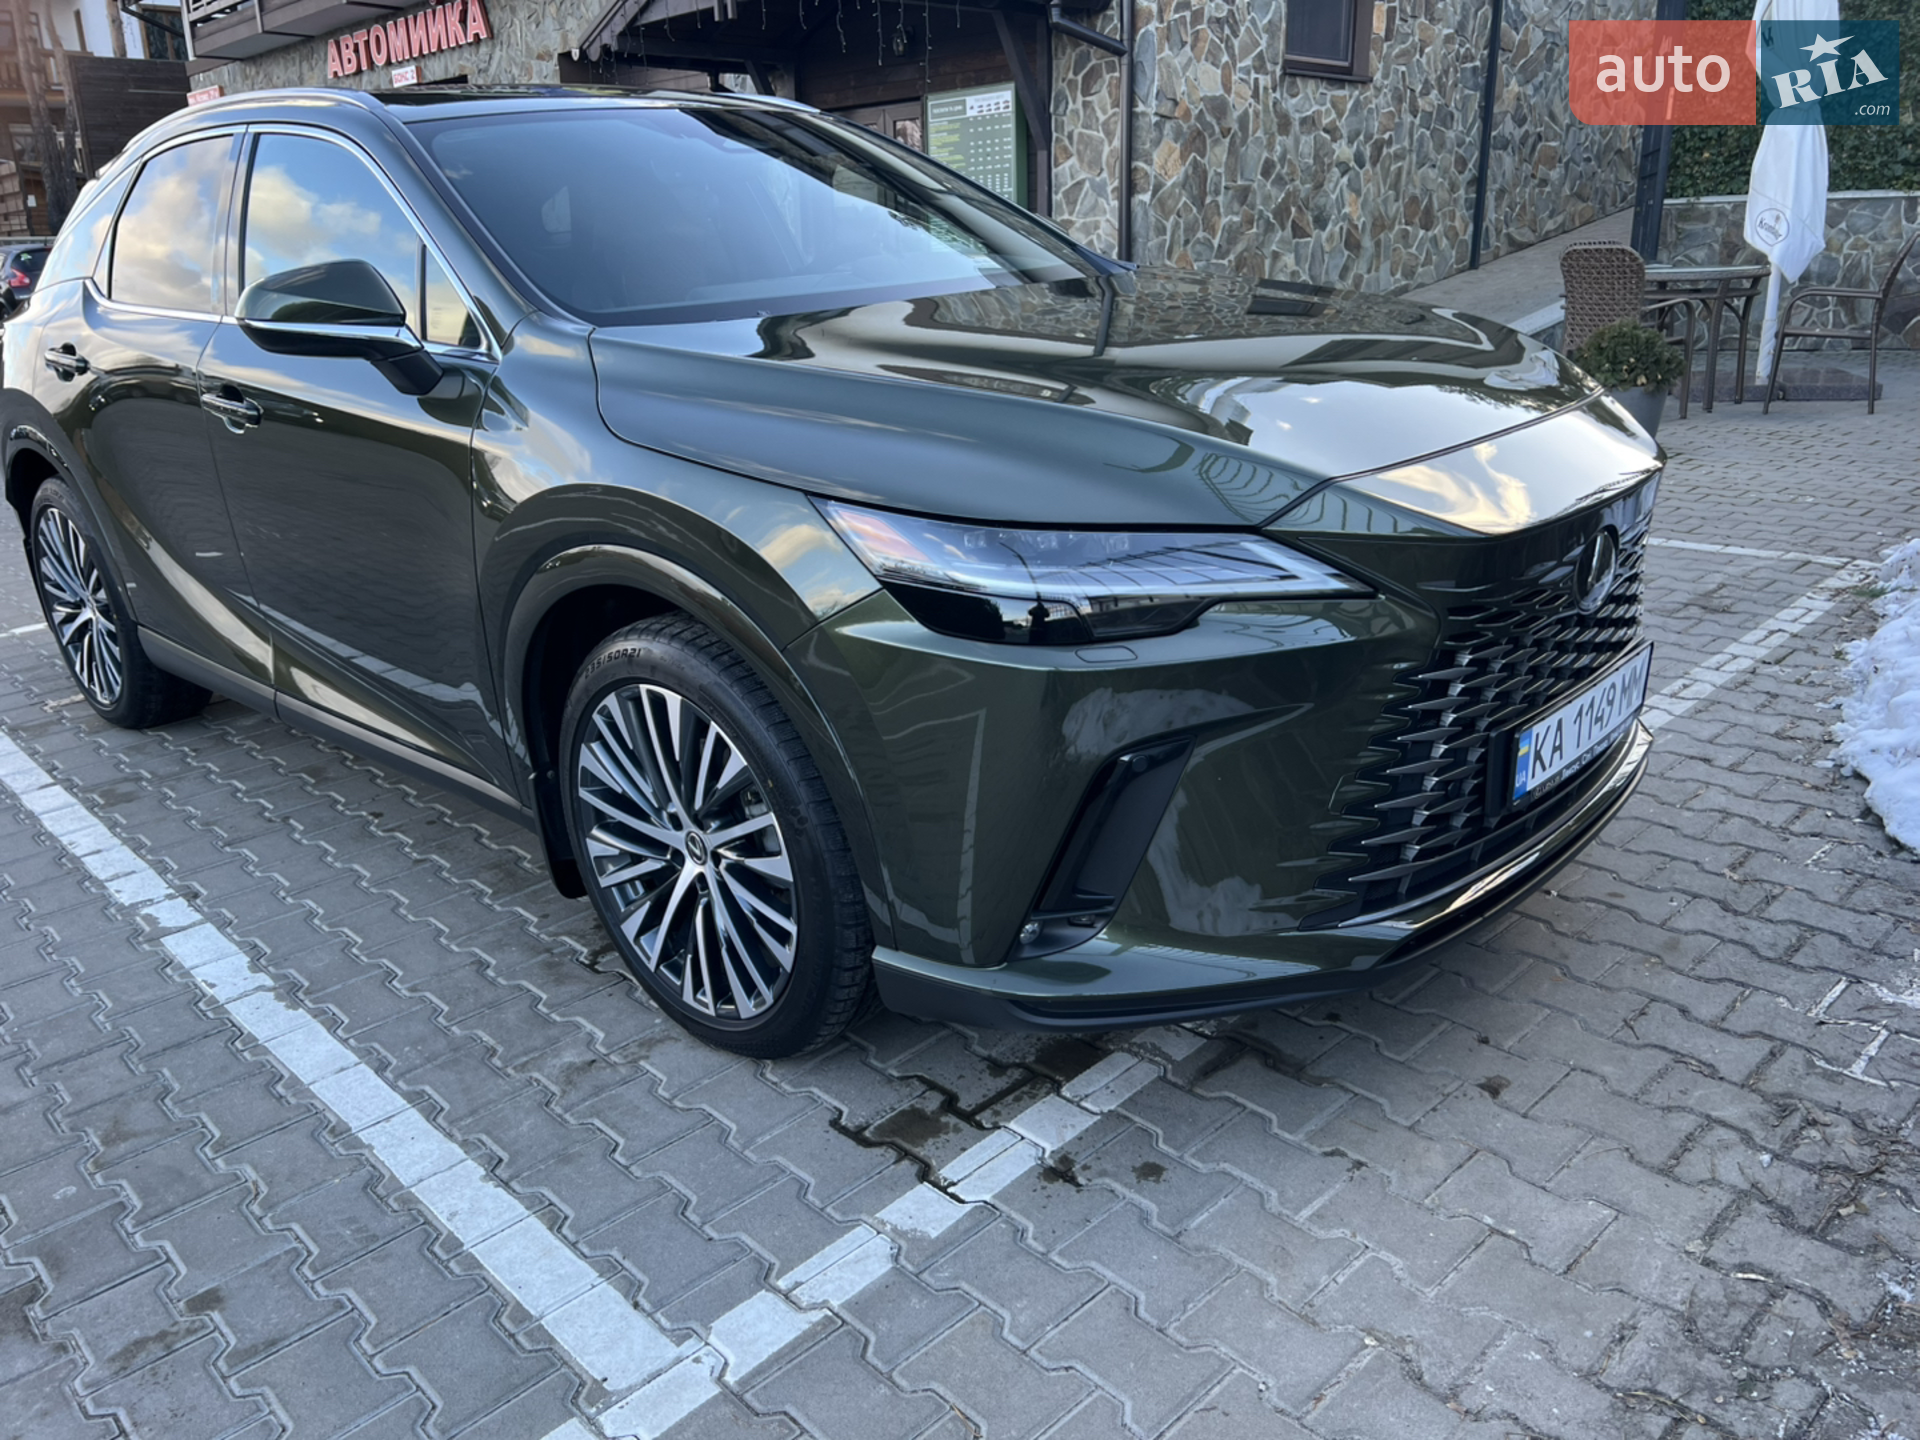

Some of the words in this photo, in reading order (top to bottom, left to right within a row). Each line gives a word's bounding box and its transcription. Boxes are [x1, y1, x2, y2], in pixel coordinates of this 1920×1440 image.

[1531, 717, 1563, 780] KA
[1573, 681, 1617, 749] 1149
[1619, 656, 1646, 717] MM
[1515, 770, 1526, 787] UA
